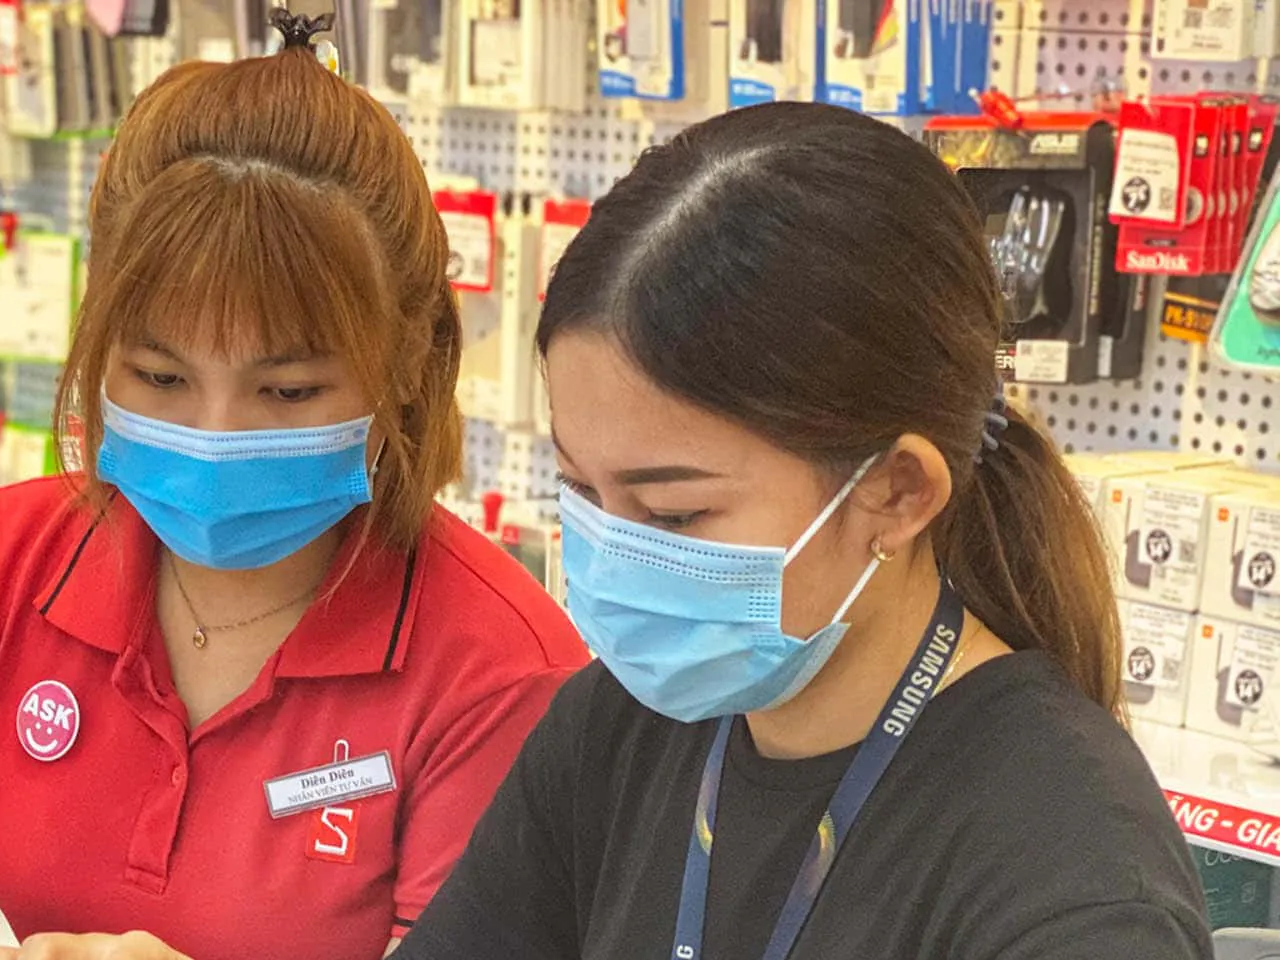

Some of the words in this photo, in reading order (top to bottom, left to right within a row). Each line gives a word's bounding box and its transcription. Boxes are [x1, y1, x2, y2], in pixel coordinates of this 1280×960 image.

[1126, 250, 1190, 273] SanDisk
[882, 624, 957, 738] SAMSUNG
[22, 693, 74, 730] ASK
